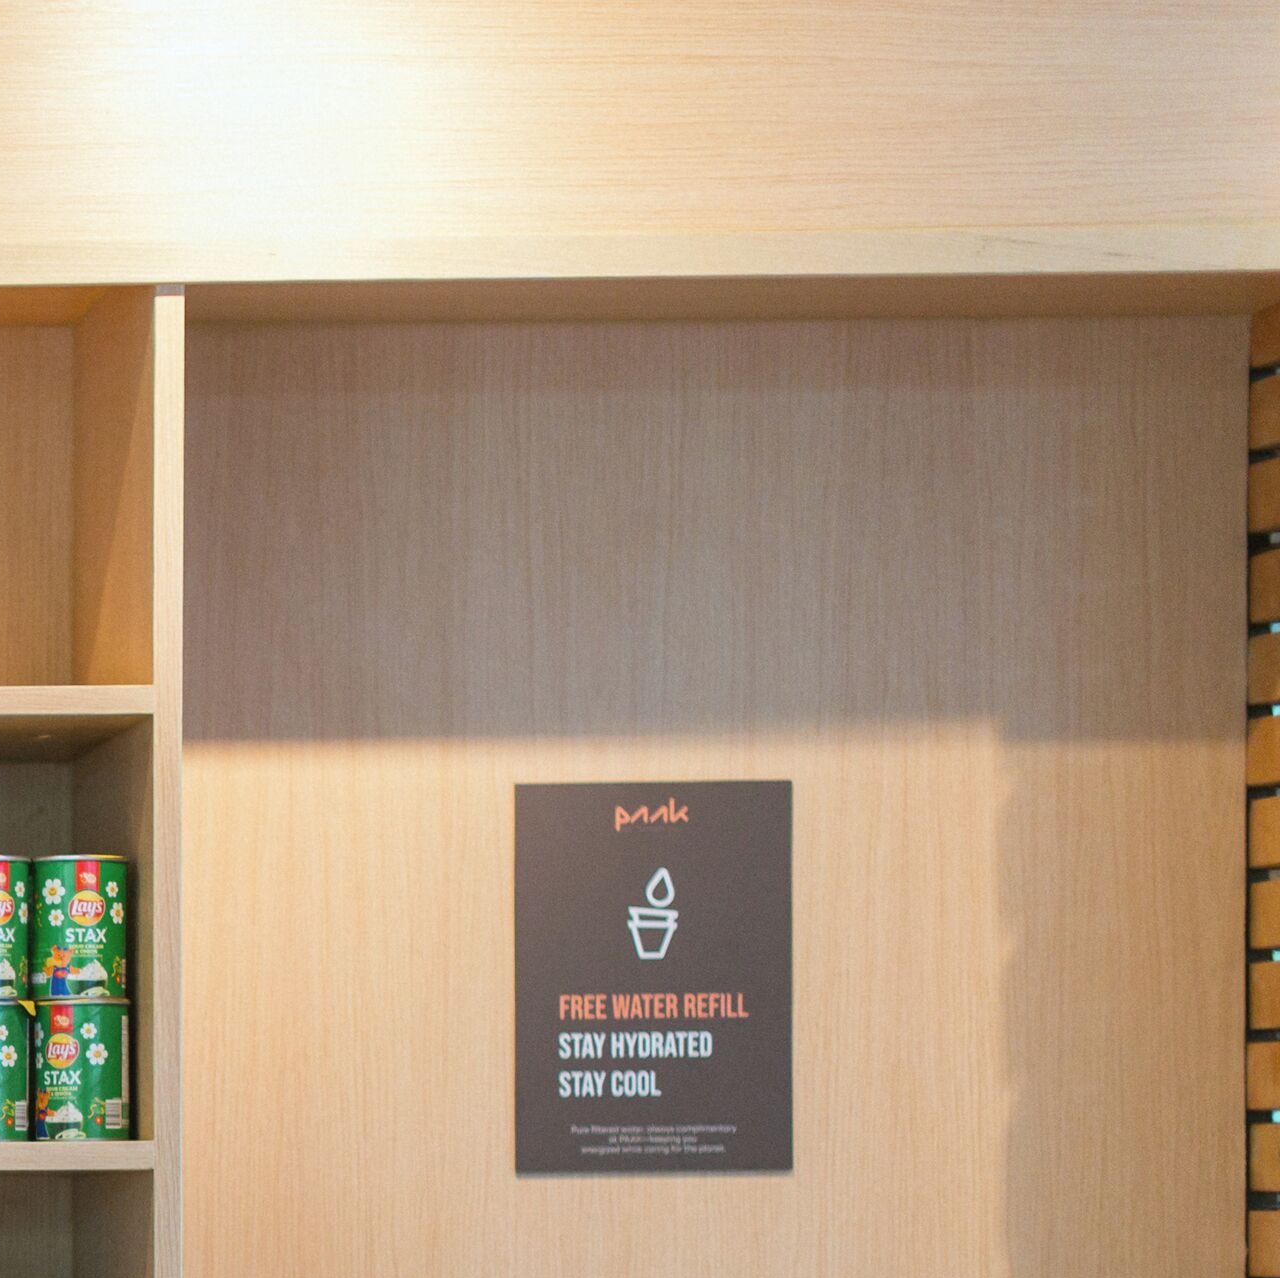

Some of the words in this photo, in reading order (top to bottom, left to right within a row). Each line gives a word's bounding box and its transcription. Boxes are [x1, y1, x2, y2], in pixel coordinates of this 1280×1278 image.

[72, 899, 103, 918] Lay's
[65, 928, 107, 943] STAX
[559, 994, 607, 1020] FREE
[612, 993, 678, 1019] WATER
[684, 992, 749, 1018] REFILL
[48, 1042, 76, 1060] Lay's
[558, 1032, 606, 1059] STAY
[611, 1031, 713, 1058] HYDRATED
[44, 1070, 81, 1085] STAX
[558, 1071, 605, 1098] STAY
[611, 1070, 661, 1097] COOL
